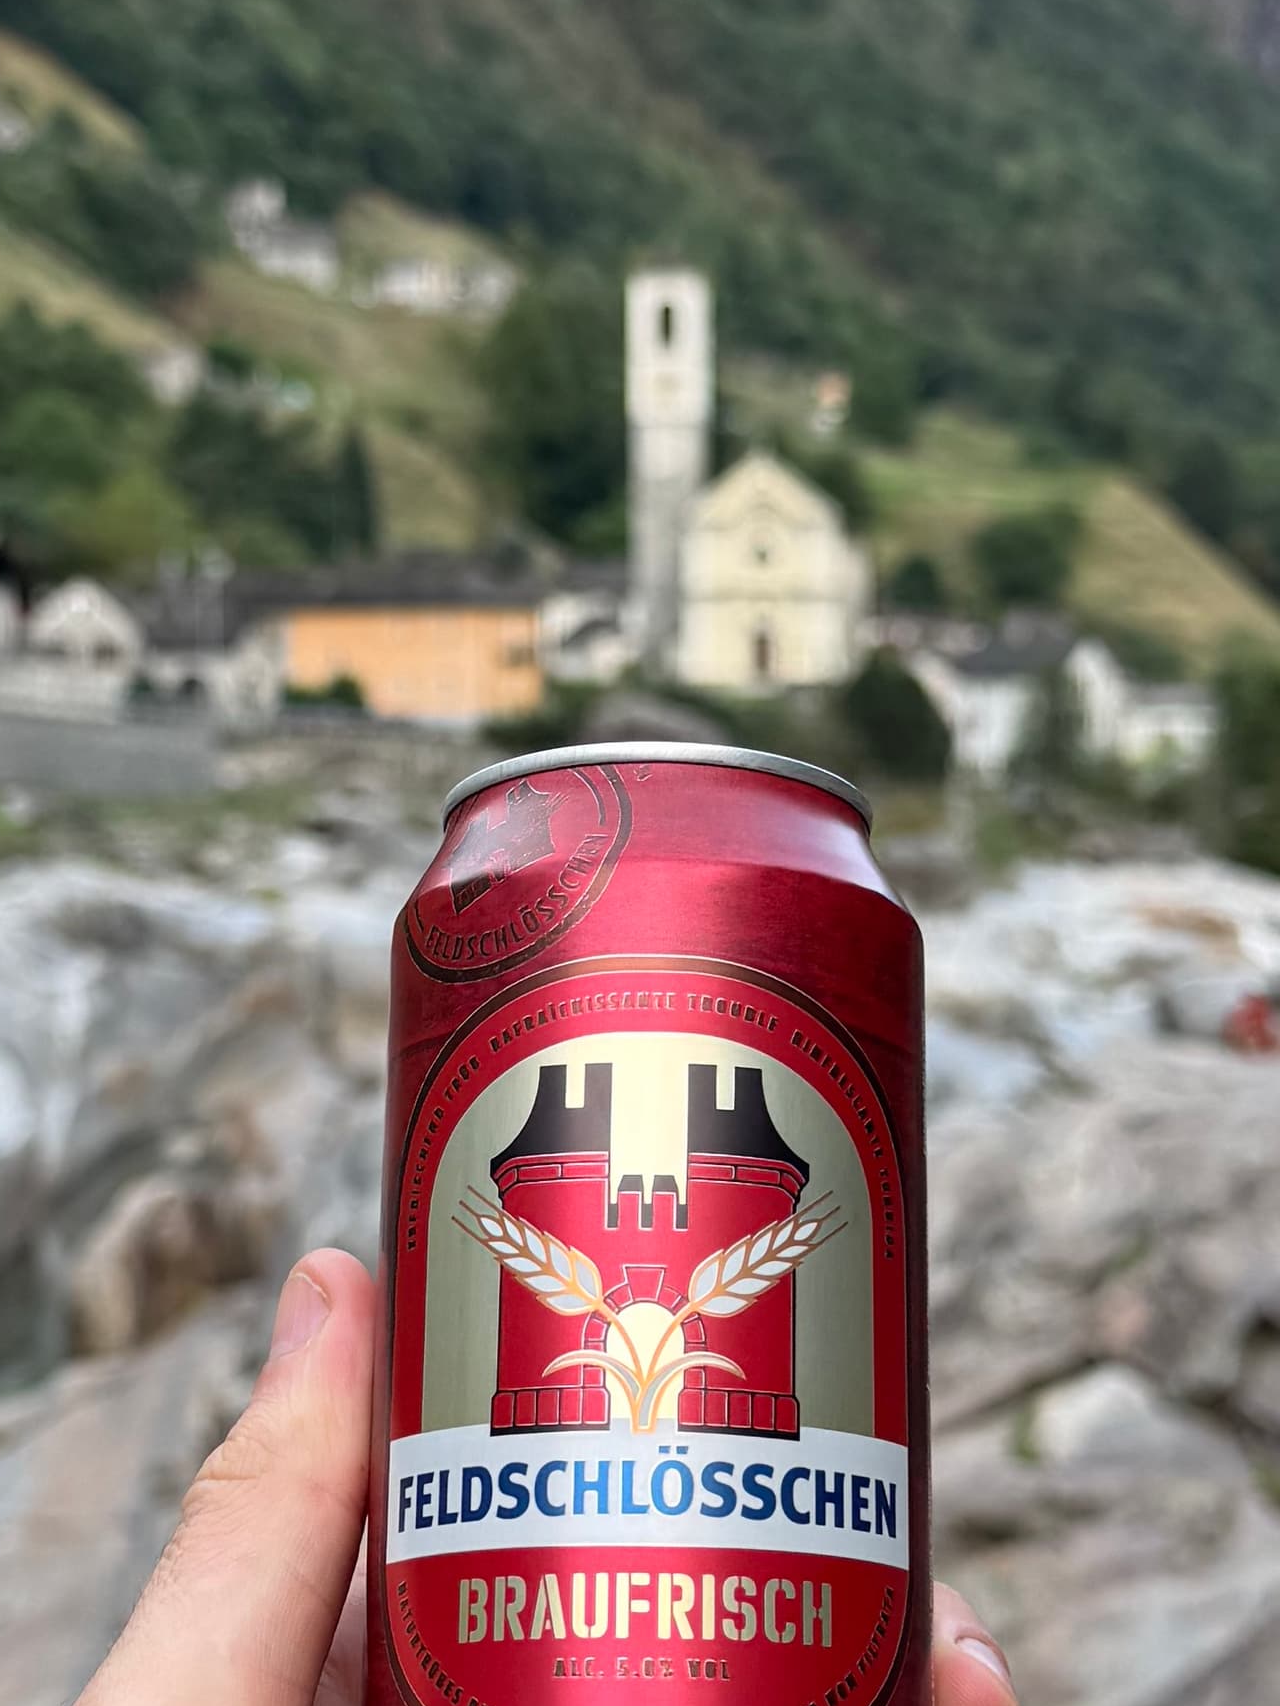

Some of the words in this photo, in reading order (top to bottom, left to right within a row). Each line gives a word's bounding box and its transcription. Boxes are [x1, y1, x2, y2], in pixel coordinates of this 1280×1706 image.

[426, 833, 608, 961] FELDSCHLÖSSCHEN
[397, 1445, 898, 1539] FELDSCHLÖSSCHEN
[458, 1571, 832, 1648] BRAUFRISCH
[552, 1656, 605, 1680] ALC.
[686, 1657, 730, 1682] VOL
